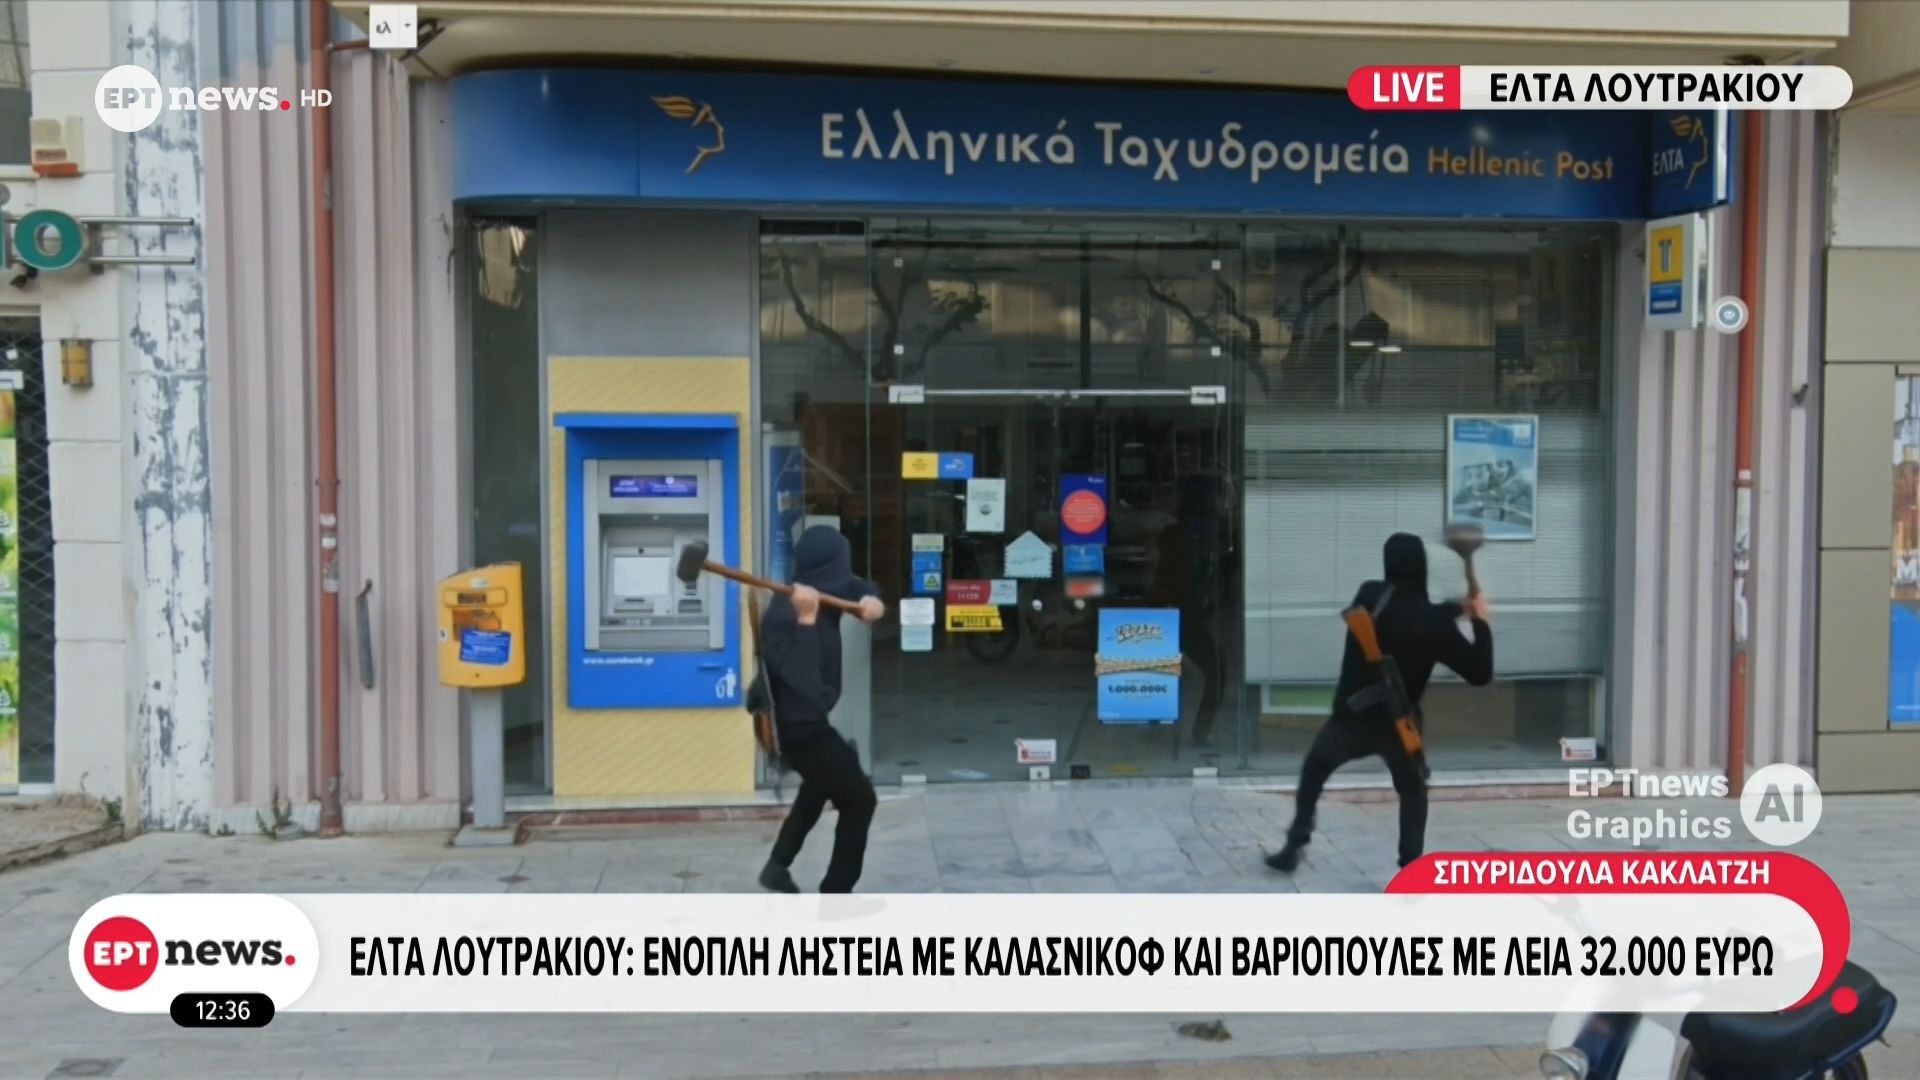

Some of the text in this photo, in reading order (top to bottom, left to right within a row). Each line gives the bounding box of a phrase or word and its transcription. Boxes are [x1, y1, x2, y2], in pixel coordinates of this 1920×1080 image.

[821, 107, 1615, 185] Ελληνικά Ταχυδρομεία Hellenic Post
[1652, 146, 1685, 177] ΕΛΤΑ
